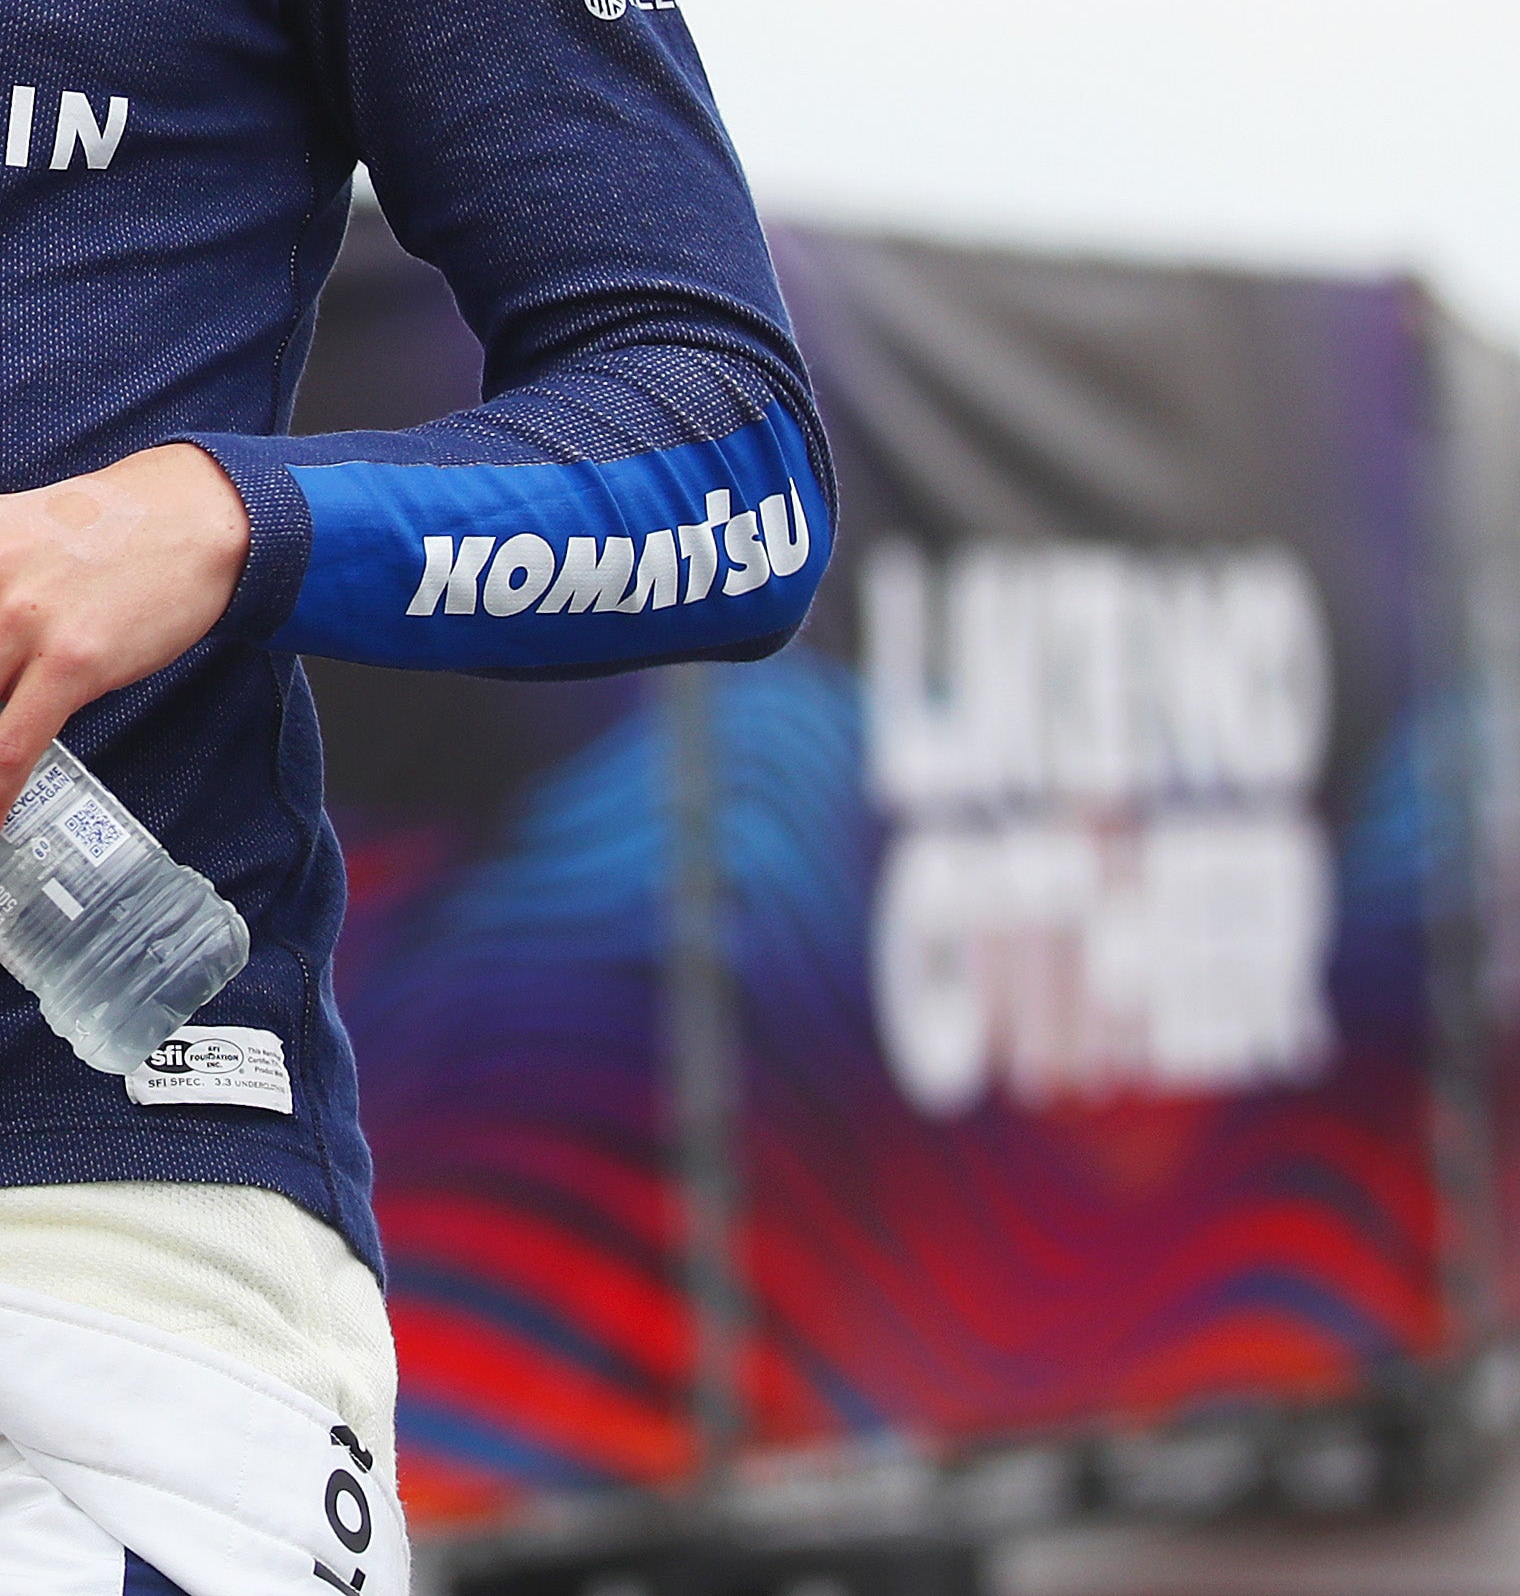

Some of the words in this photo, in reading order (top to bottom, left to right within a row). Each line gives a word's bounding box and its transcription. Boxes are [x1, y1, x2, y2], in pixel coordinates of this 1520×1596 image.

[405, 477, 811, 617] KOMATSU
[3, 779, 48, 826] ECYCLE
[44, 766, 63, 784] ME
[40, 775, 71, 805] AGAIN
[150, 1044, 183, 1066] sfi
[148, 1079, 167, 1089] SFI
[171, 1078, 205, 1087] SPEC.
[214, 1078, 232, 1087] 3.3
